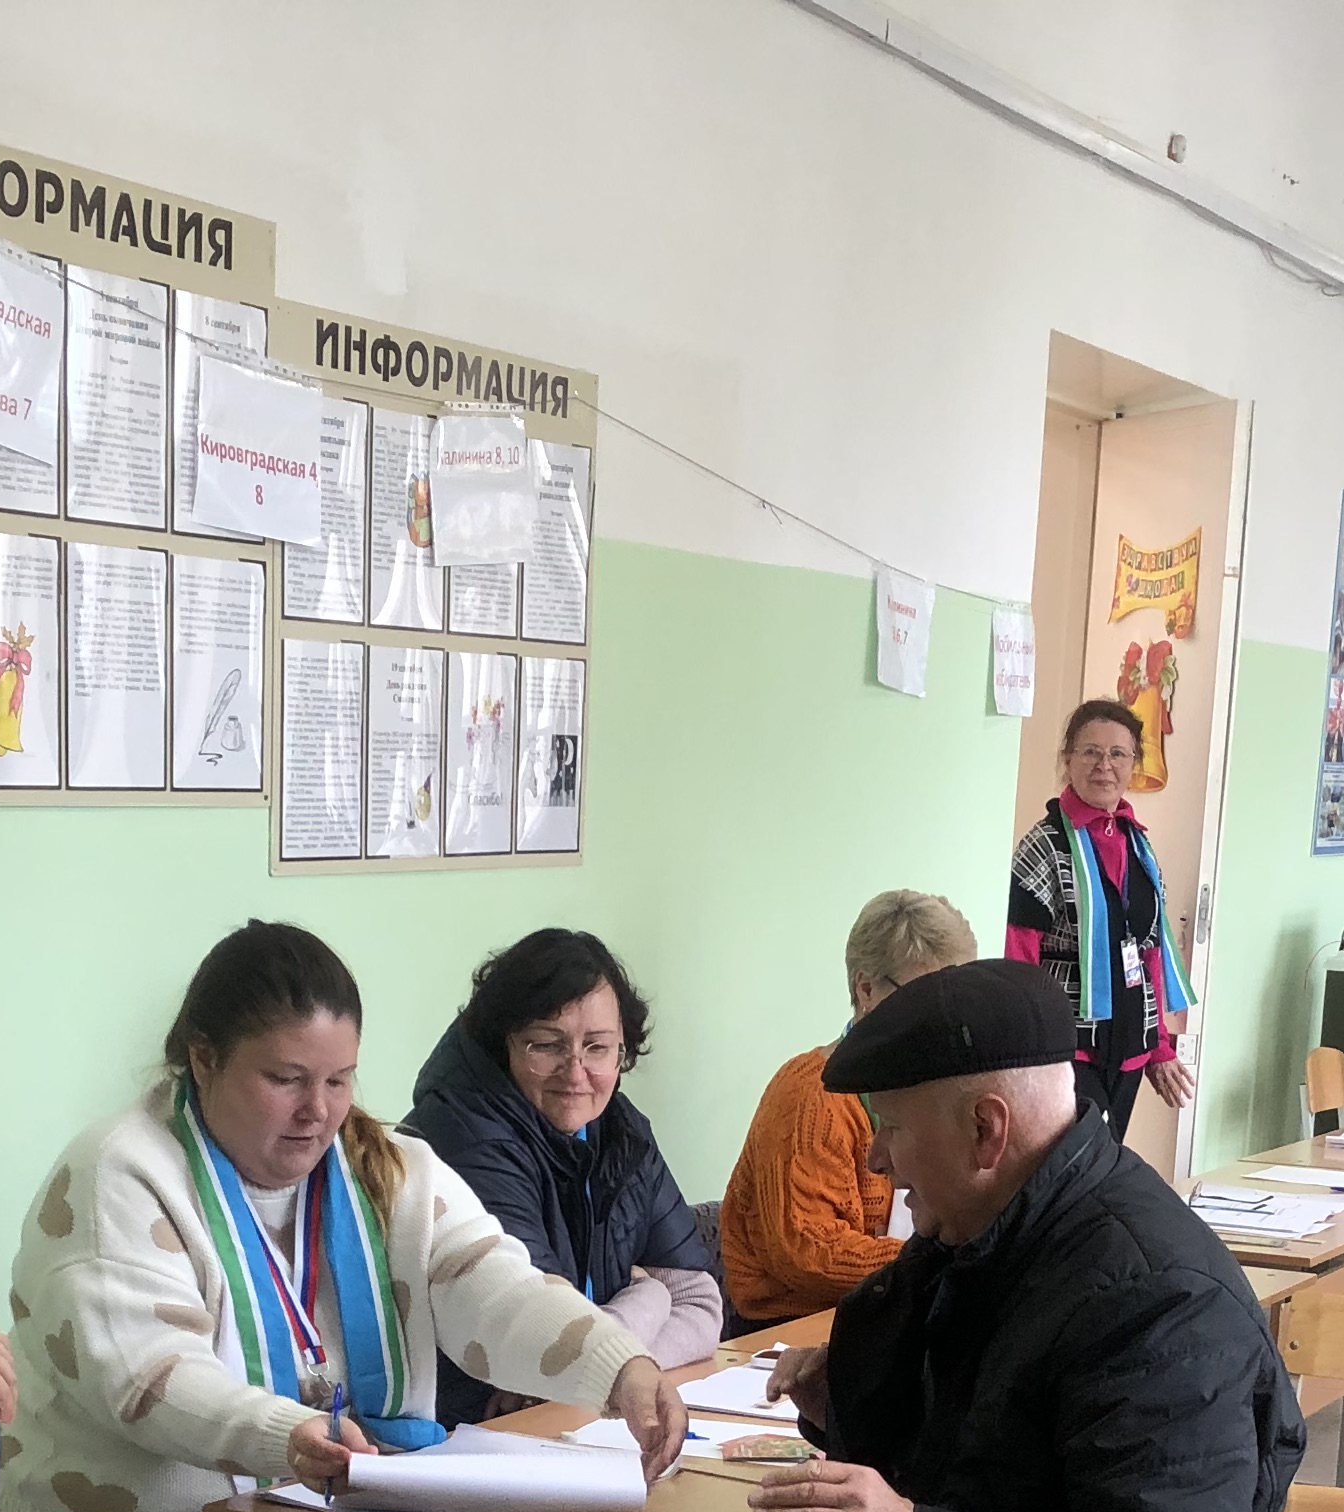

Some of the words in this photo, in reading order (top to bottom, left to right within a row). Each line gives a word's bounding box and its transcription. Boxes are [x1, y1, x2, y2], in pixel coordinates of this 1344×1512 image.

[204, 316, 210, 327] 8
[211, 320, 241, 335] сентября
[315, 317, 569, 419] ИНФОРМАЦИЯ
[22, 398, 33, 420] 7
[200, 432, 307, 480] Кировградская
[508, 446, 520, 466] 10
[255, 484, 264, 506] 8
